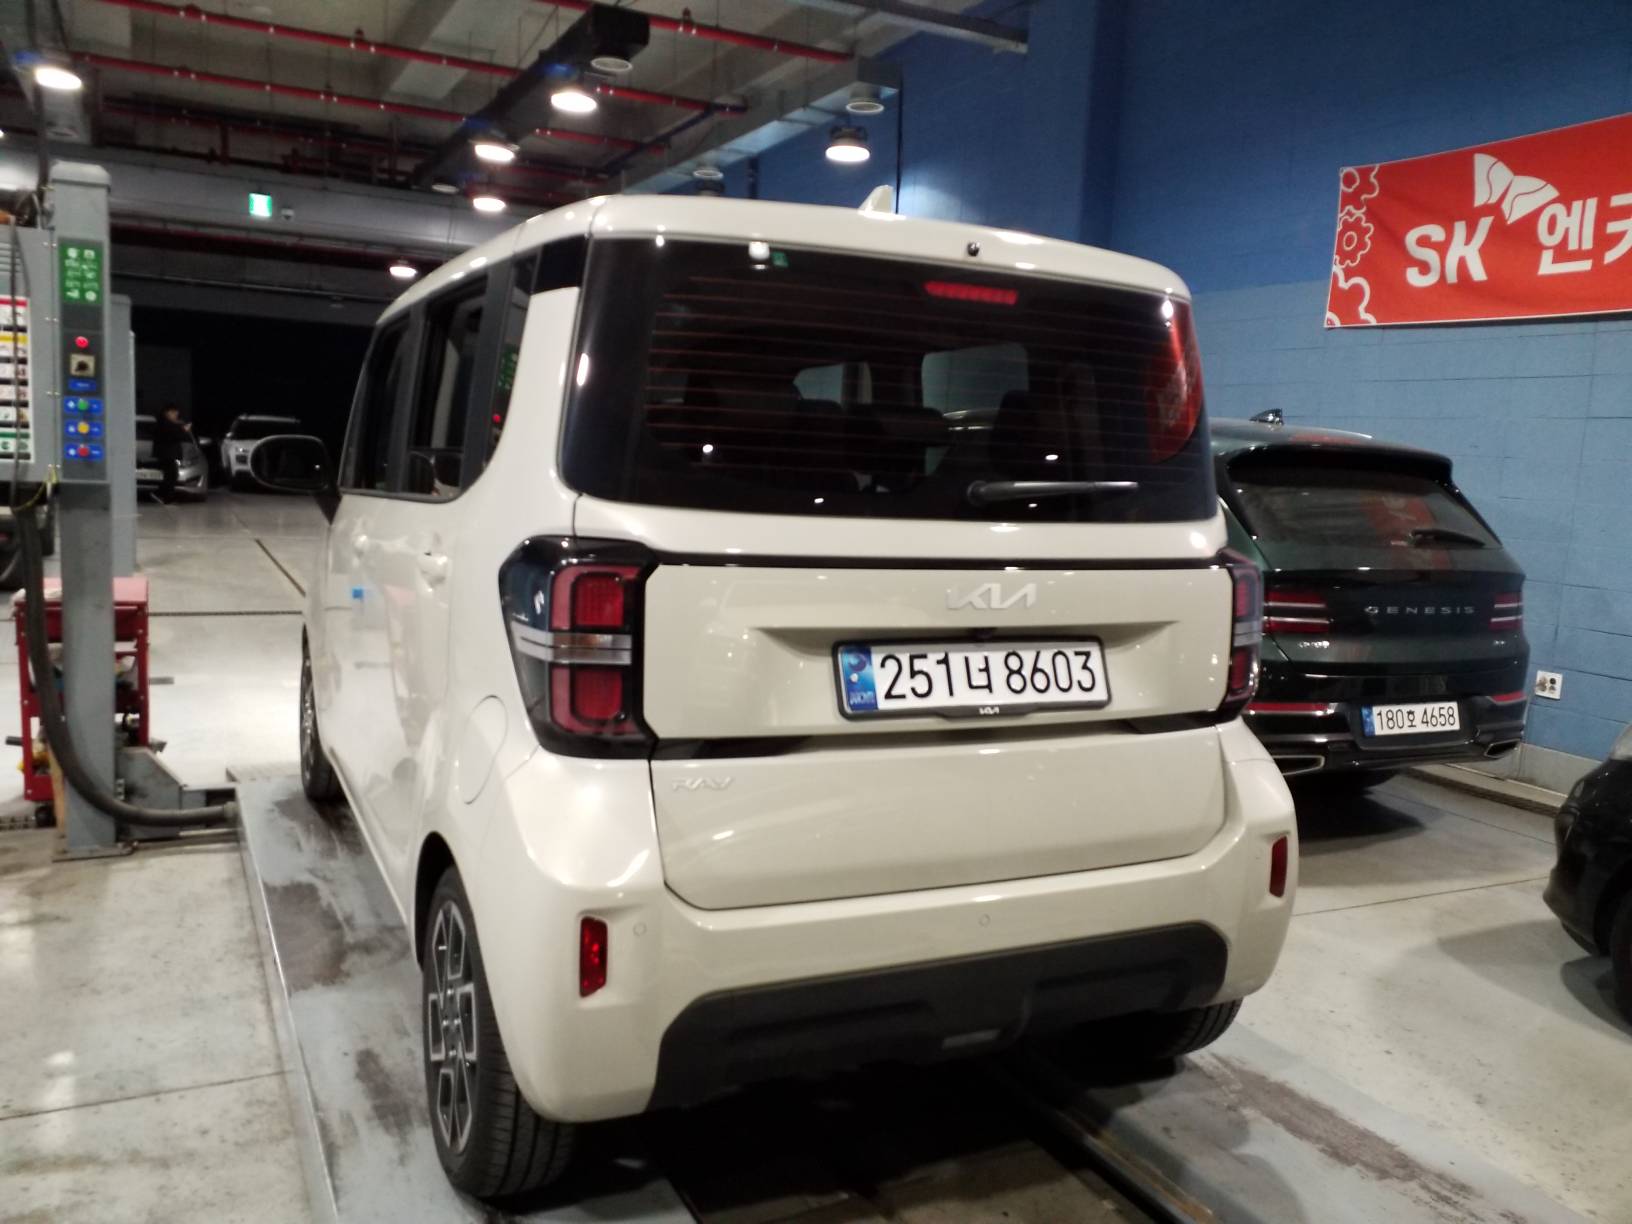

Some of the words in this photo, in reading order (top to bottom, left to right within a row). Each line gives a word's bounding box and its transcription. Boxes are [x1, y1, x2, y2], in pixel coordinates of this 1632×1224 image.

[1405, 216, 1495, 288] SK
[945, 583, 1037, 610] KIA
[1364, 606, 1474, 614] GENESIS
[1004, 650, 1096, 694] 8603
[1421, 706, 1456, 727] 4658
